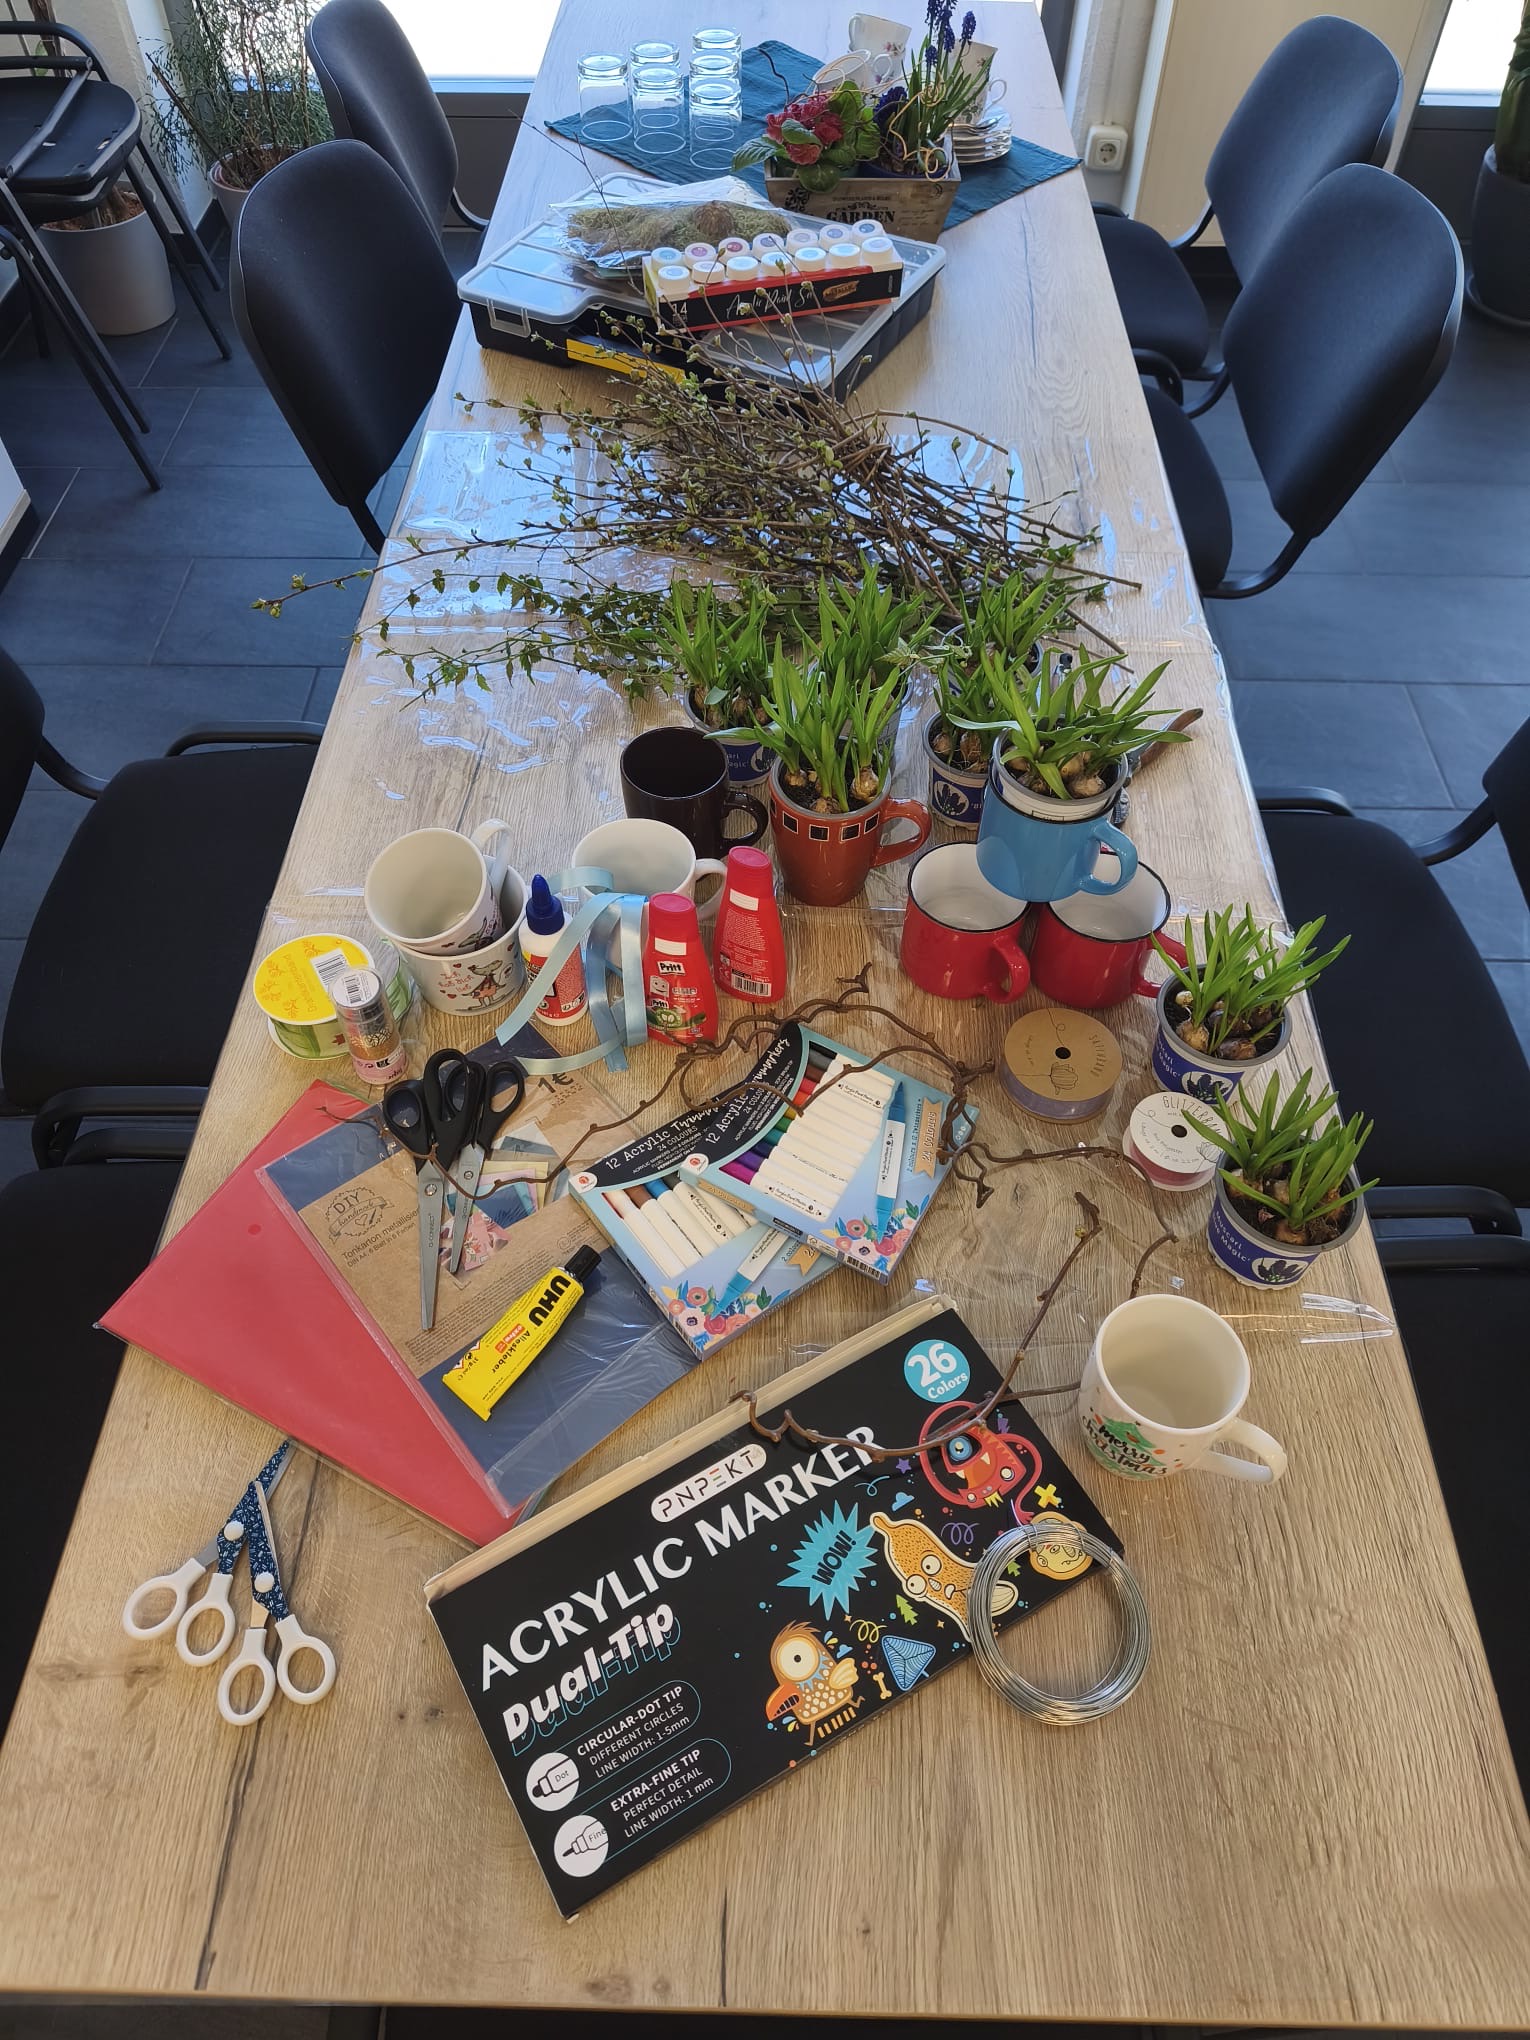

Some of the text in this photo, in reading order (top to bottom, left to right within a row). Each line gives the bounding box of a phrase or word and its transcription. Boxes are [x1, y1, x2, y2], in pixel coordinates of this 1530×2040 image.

[826, 211, 895, 223] GARDEN
[659, 962, 682, 973] Pritt
[656, 1125, 698, 1153] 24 COLOURS
[705, 1132, 721, 1144] 12
[715, 1094, 749, 1133] Acrylic
[605, 1157, 622, 1170] 12
[623, 1130, 671, 1162] Acrylic
[333, 1191, 361, 1214] DIY
[342, 1232, 382, 1259] Tonkarton
[528, 1275, 571, 1327] UHU
[491, 1329, 531, 1374] Alleskleber
[907, 1342, 957, 1388] 26
[927, 1372, 968, 1399] Colors
[1098, 1424, 1151, 1465] merry
[481, 1425, 880, 1693] ACRYLIC MARKER
[811, 1530, 857, 1586] WOW!
[502, 1602, 677, 1747] Dual-Tip
[577, 1685, 684, 1757] CIRCULAR-DOT TIP
[588, 1702, 685, 1766] DIFFERENT CIRCLES
[594, 1715, 691, 1779] LINE WIDTH: 1-5mm
[554, 1769, 570, 1784] Dot
[609, 1748, 701, 1813] EXTRA-FINE TIP
[622, 1766, 704, 1822] PERFECT DETAIL
[624, 1776, 715, 1839] LINE WIDTH: 1 mm
[587, 1827, 608, 1843] Fine
